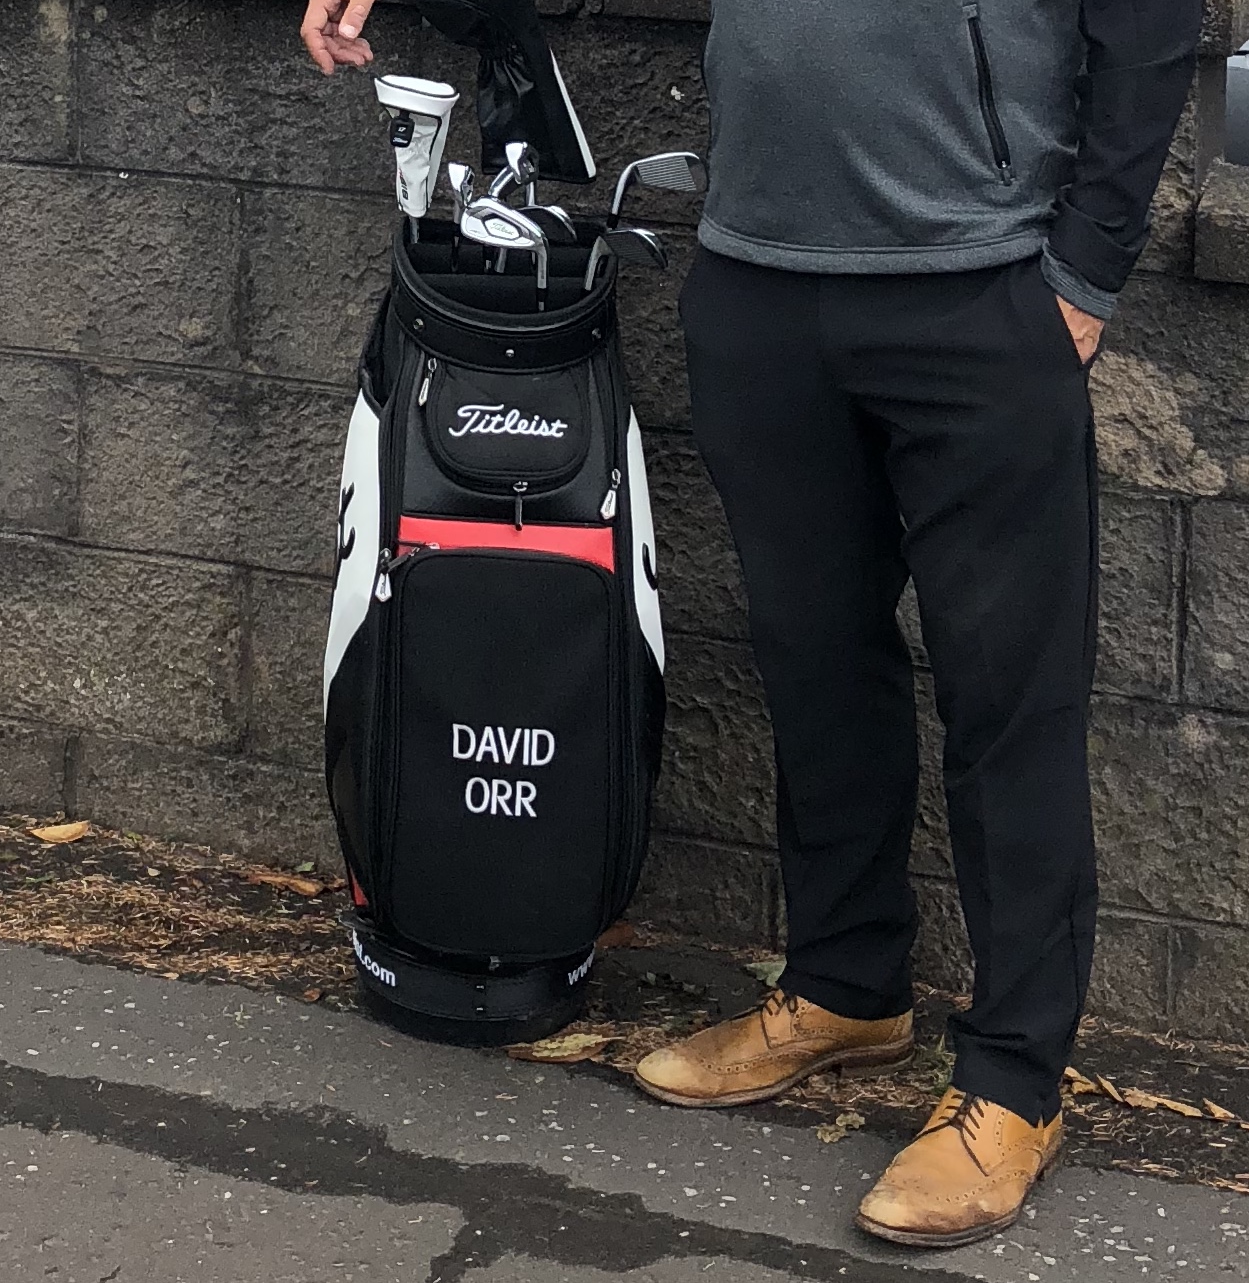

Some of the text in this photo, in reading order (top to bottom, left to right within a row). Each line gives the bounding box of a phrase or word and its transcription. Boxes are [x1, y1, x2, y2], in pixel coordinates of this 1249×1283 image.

[448, 403, 568, 438] Titleist
[452, 723, 555, 766] DAVID
[465, 776, 537, 818] ORR
